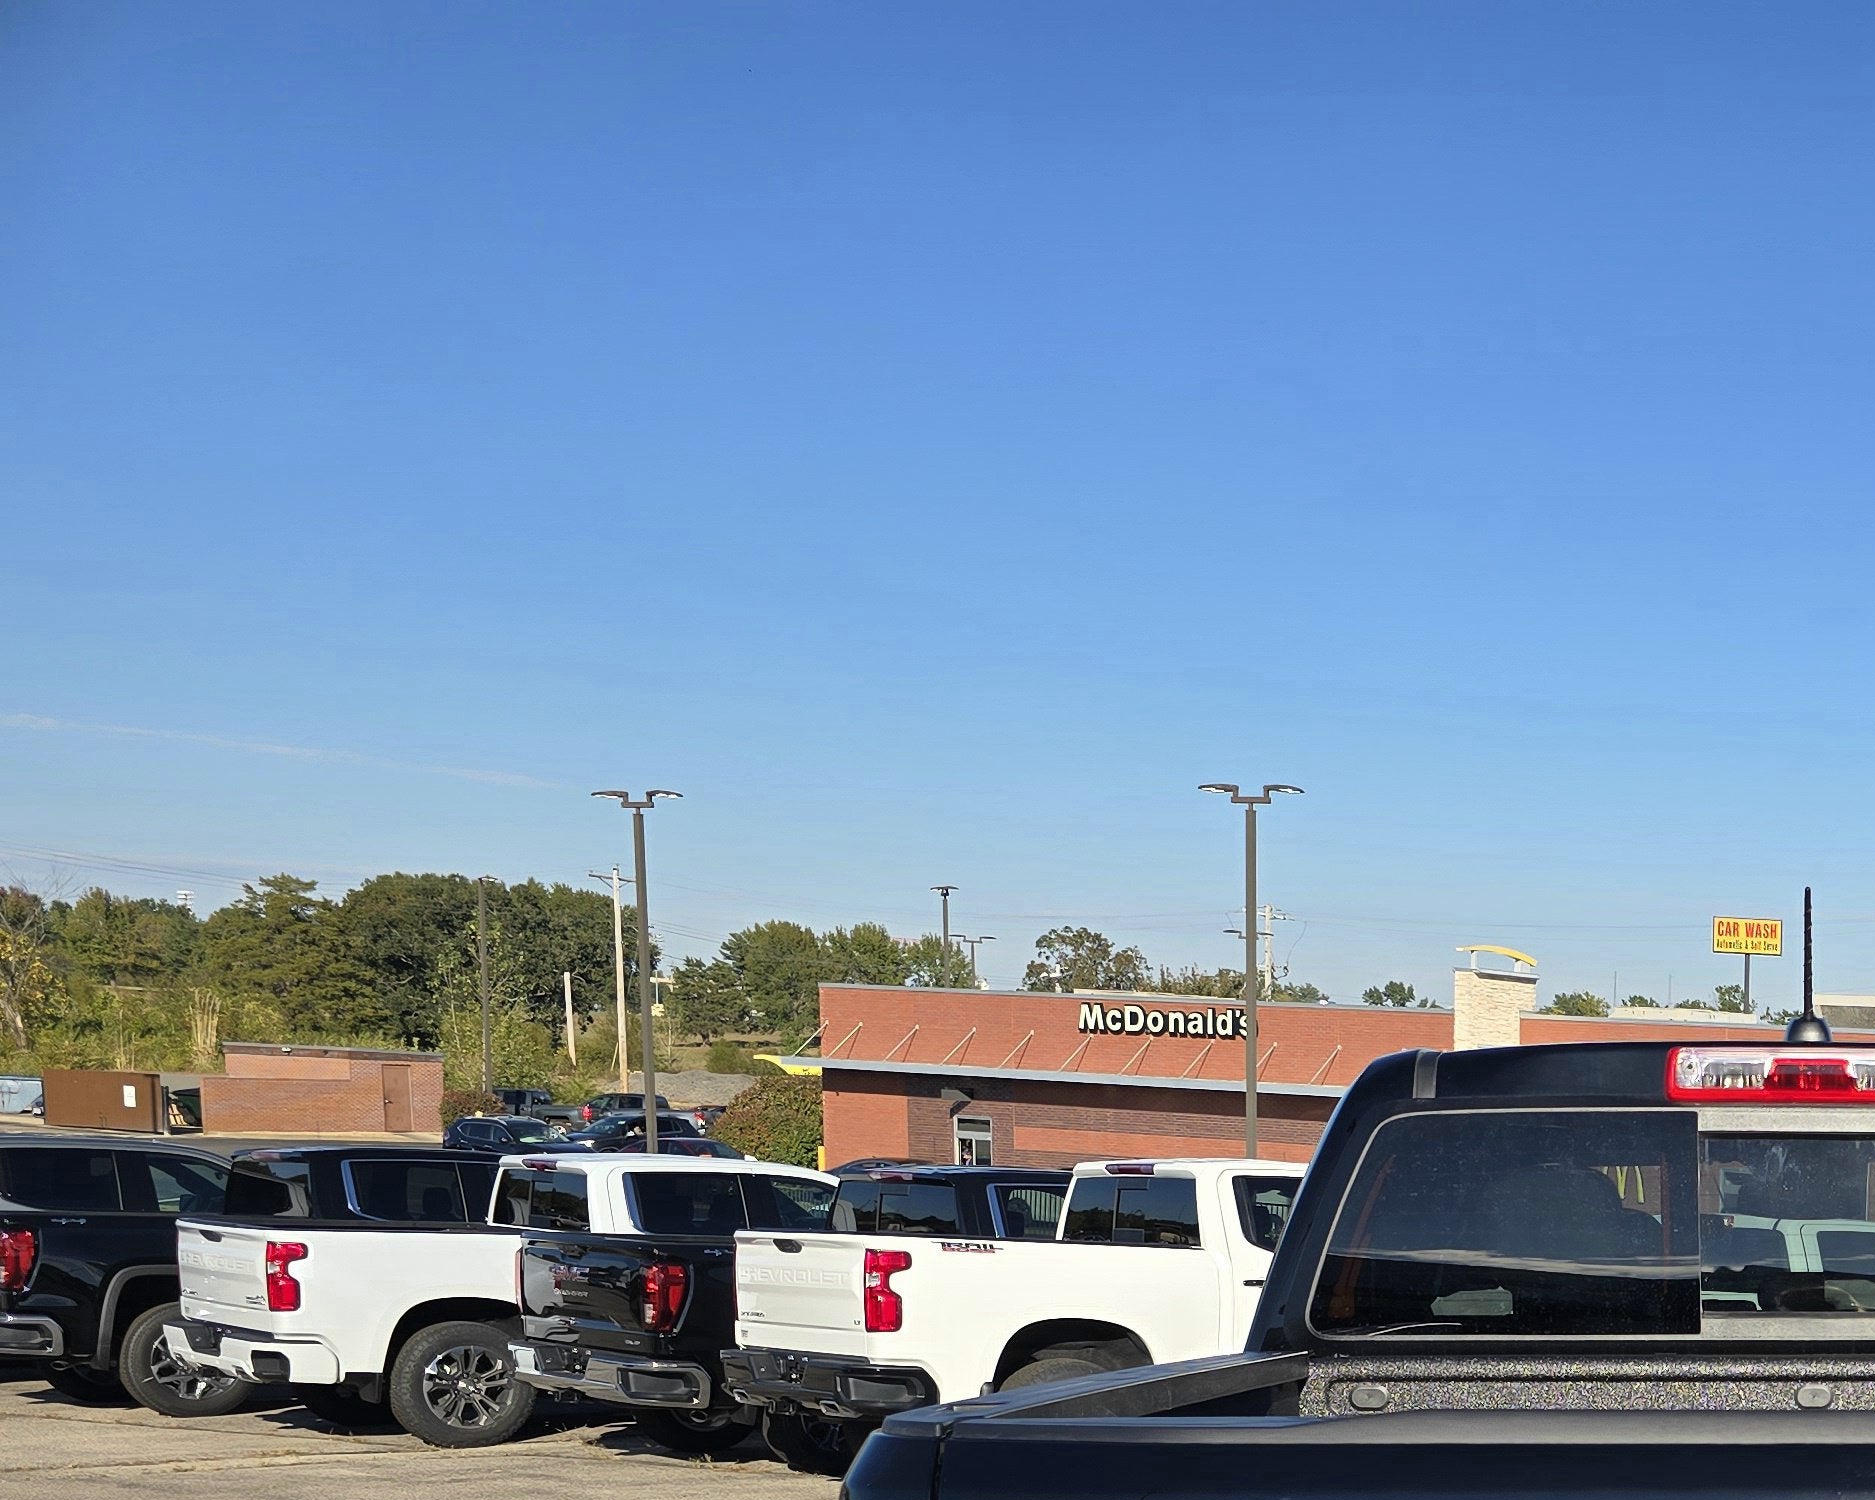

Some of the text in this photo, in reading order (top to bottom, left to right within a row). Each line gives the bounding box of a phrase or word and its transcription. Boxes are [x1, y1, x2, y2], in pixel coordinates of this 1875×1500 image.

[1718, 921, 1777, 939] CAR WASH
[1717, 939, 1742, 950] Automatic
